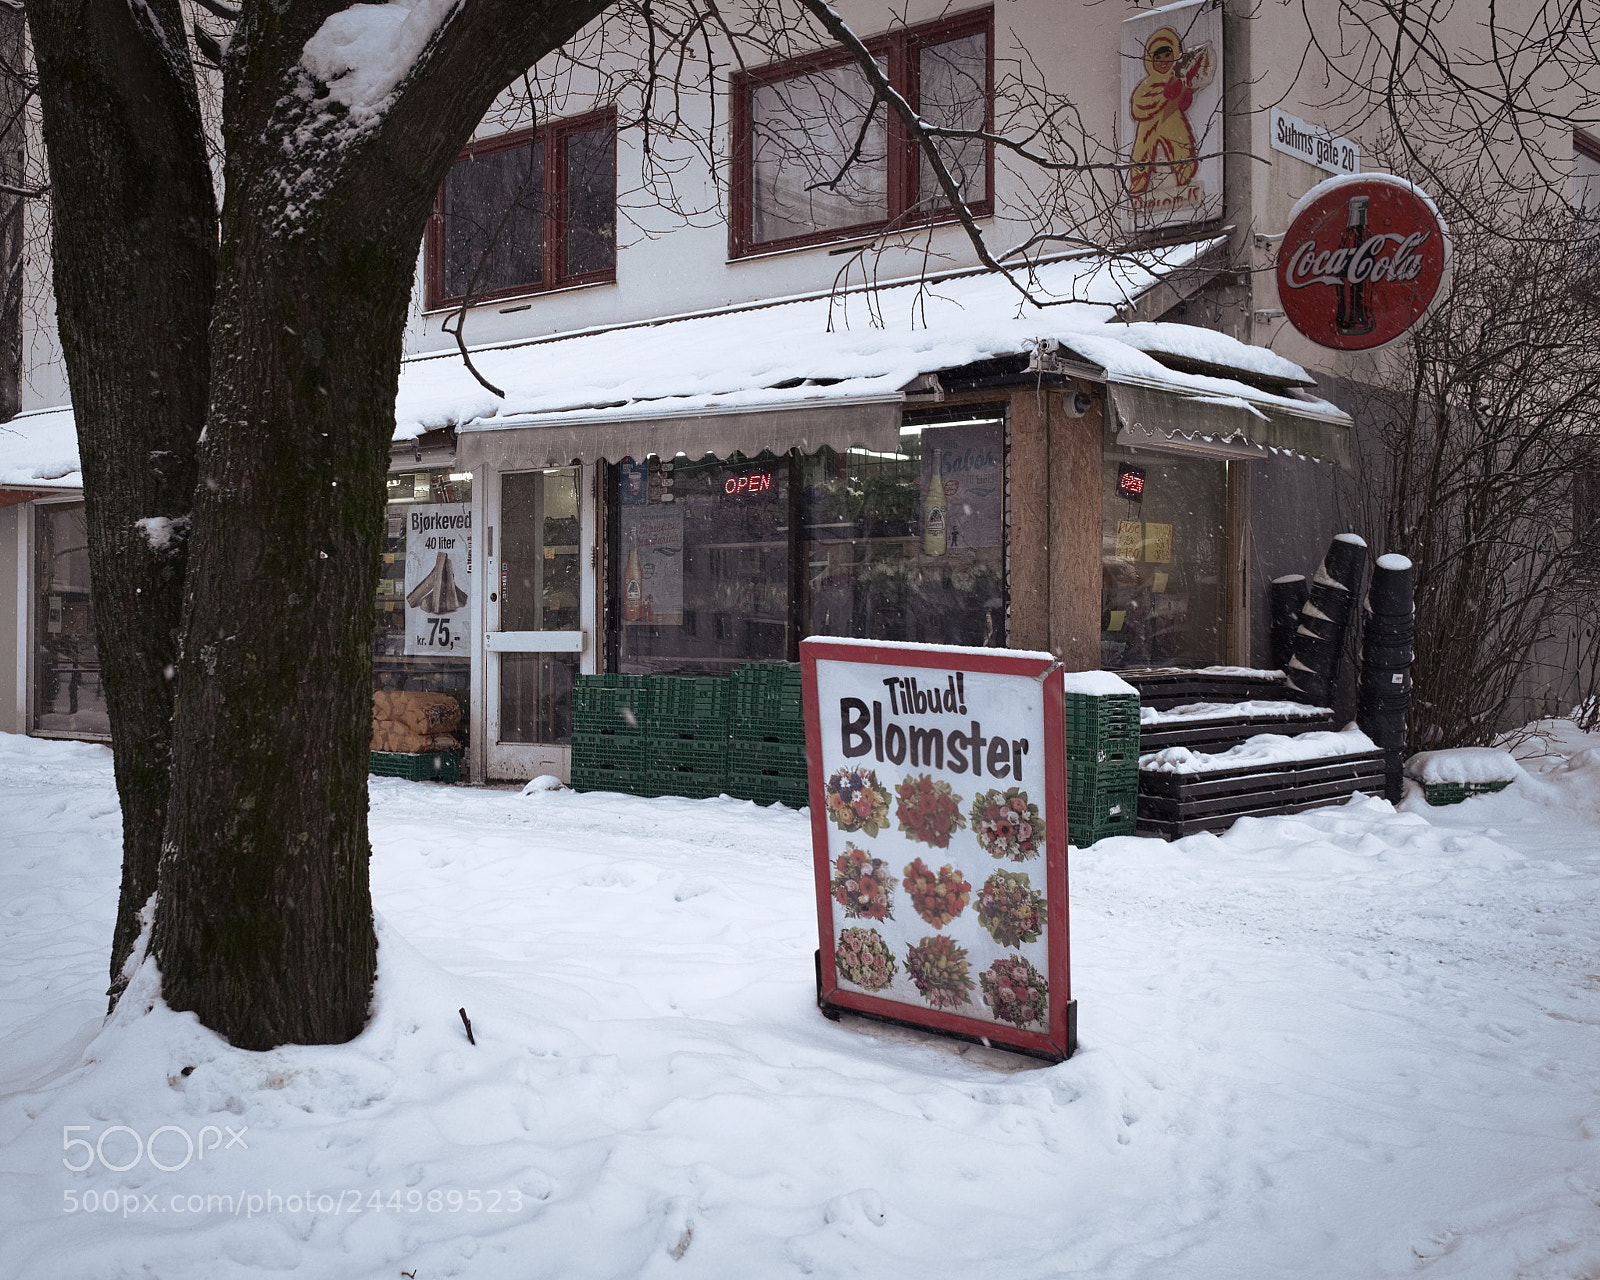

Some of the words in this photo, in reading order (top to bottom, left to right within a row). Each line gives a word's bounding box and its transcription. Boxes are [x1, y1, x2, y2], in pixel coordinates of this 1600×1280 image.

[1277, 116, 1314, 156] Suhms
[1316, 139, 1339, 166] gate
[1341, 145, 1355, 173] 20
[1285, 230, 1431, 289] Coca-Cola
[724, 473, 771, 494] OPEN
[411, 510, 472, 535] Bjørkeved
[425, 536, 437, 550] 40
[438, 536, 456, 550] liter
[882, 671, 967, 716] Tilbud!
[839, 697, 1029, 782] Blomster
